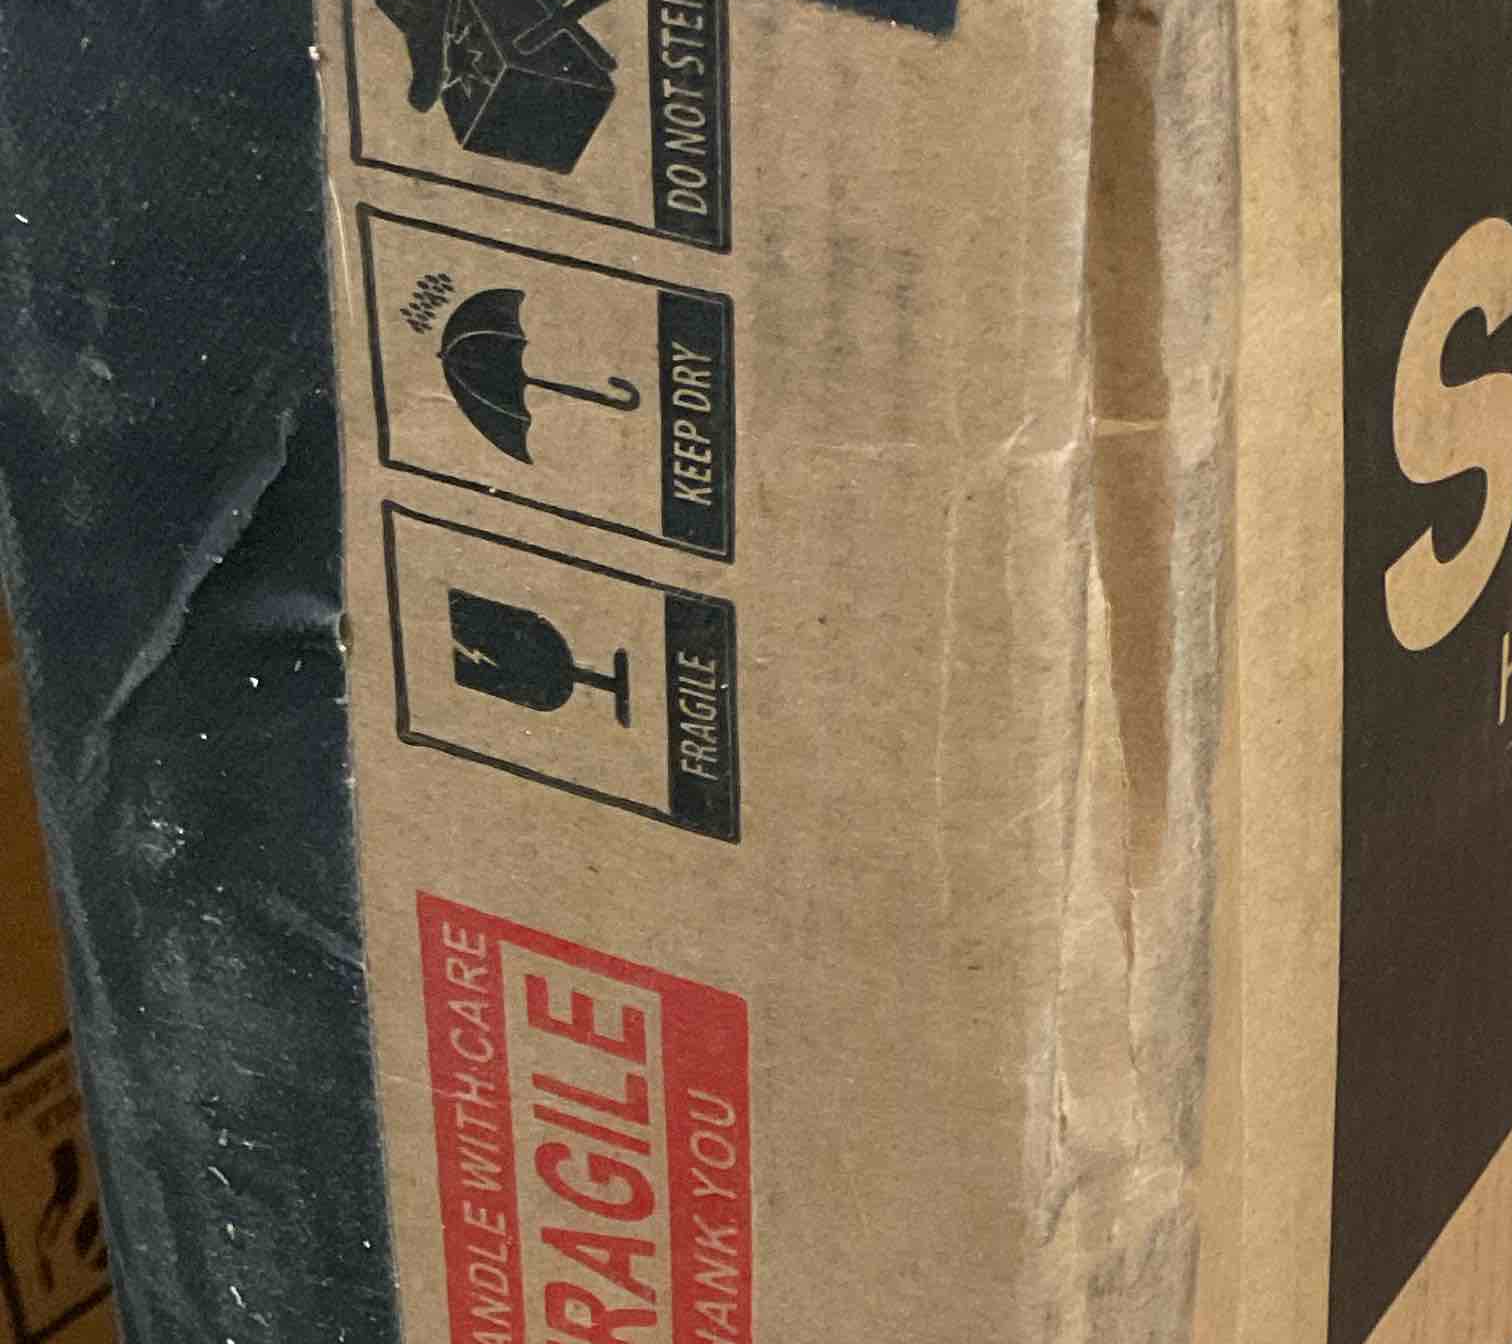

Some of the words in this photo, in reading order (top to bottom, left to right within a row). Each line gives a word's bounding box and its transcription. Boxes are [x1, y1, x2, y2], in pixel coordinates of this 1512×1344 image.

[663, 78, 707, 160] NOT
[666, 163, 708, 216] DO
[671, 341, 714, 420] DRY
[673, 419, 714, 508] KEEP
[679, 650, 719, 782] FRAGILE
[441, 920, 495, 1066] CARE
[454, 1065, 502, 1193] WITH
[687, 1087, 737, 1202] YOU
